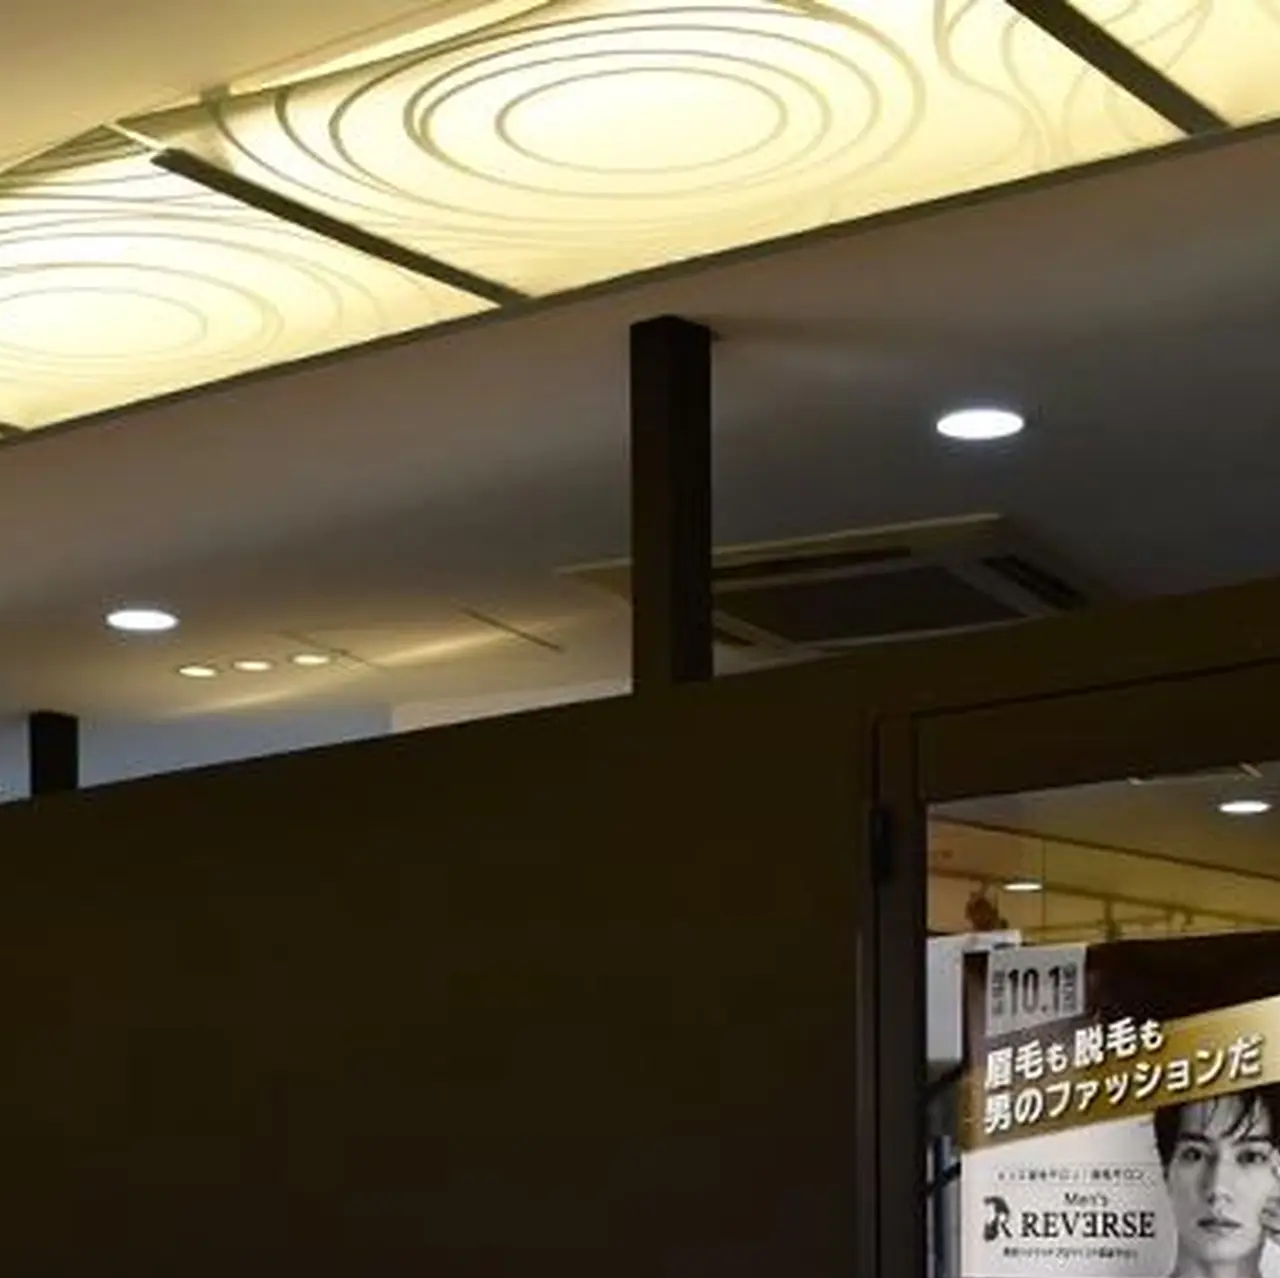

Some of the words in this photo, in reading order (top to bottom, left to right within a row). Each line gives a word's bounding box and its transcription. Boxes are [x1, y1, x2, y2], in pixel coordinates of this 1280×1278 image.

[984, 1032, 1265, 1136] 男のファッションだ
